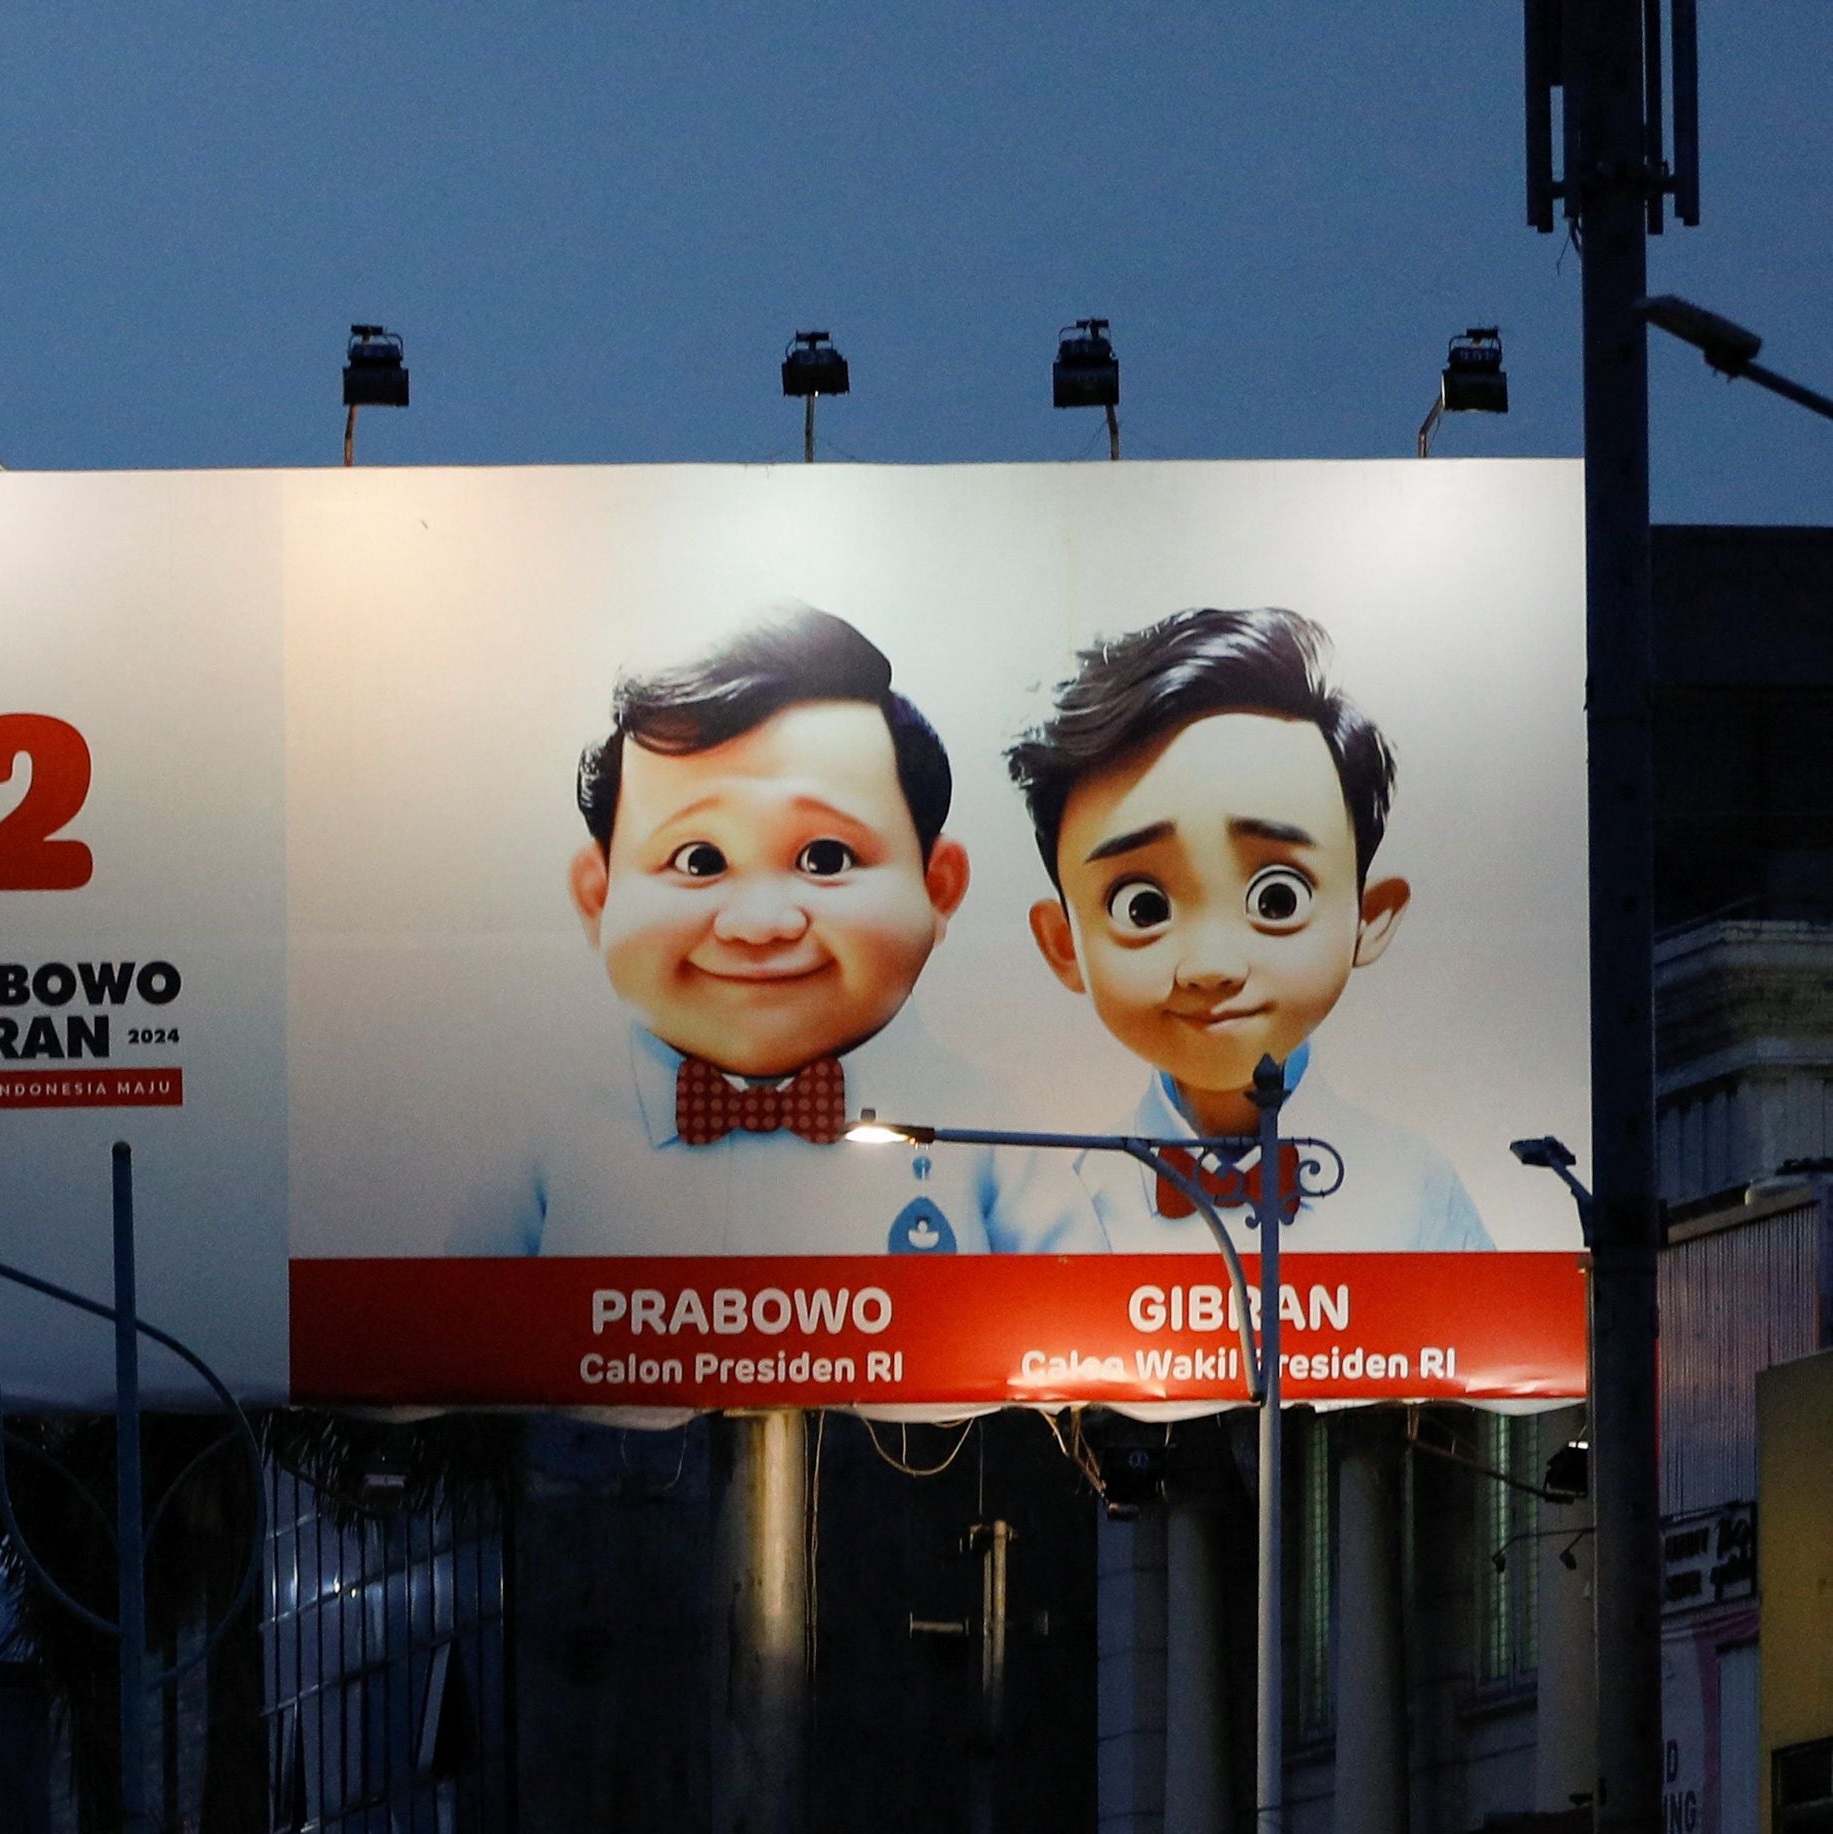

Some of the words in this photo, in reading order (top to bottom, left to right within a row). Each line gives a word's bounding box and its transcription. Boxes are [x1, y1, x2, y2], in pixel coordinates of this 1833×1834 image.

[128, 1028, 180, 1044] 2024
[117, 1080, 171, 1095] MAJU
[592, 1286, 893, 1335] PRABOWO
[580, 1353, 683, 1384] Calon
[695, 1351, 855, 1383] Presiden
[867, 1350, 903, 1382] RI
[1135, 1350, 1237, 1380] Wakil
[1258, 1347, 1408, 1380] residen
[1421, 1348, 1456, 1379] RI
